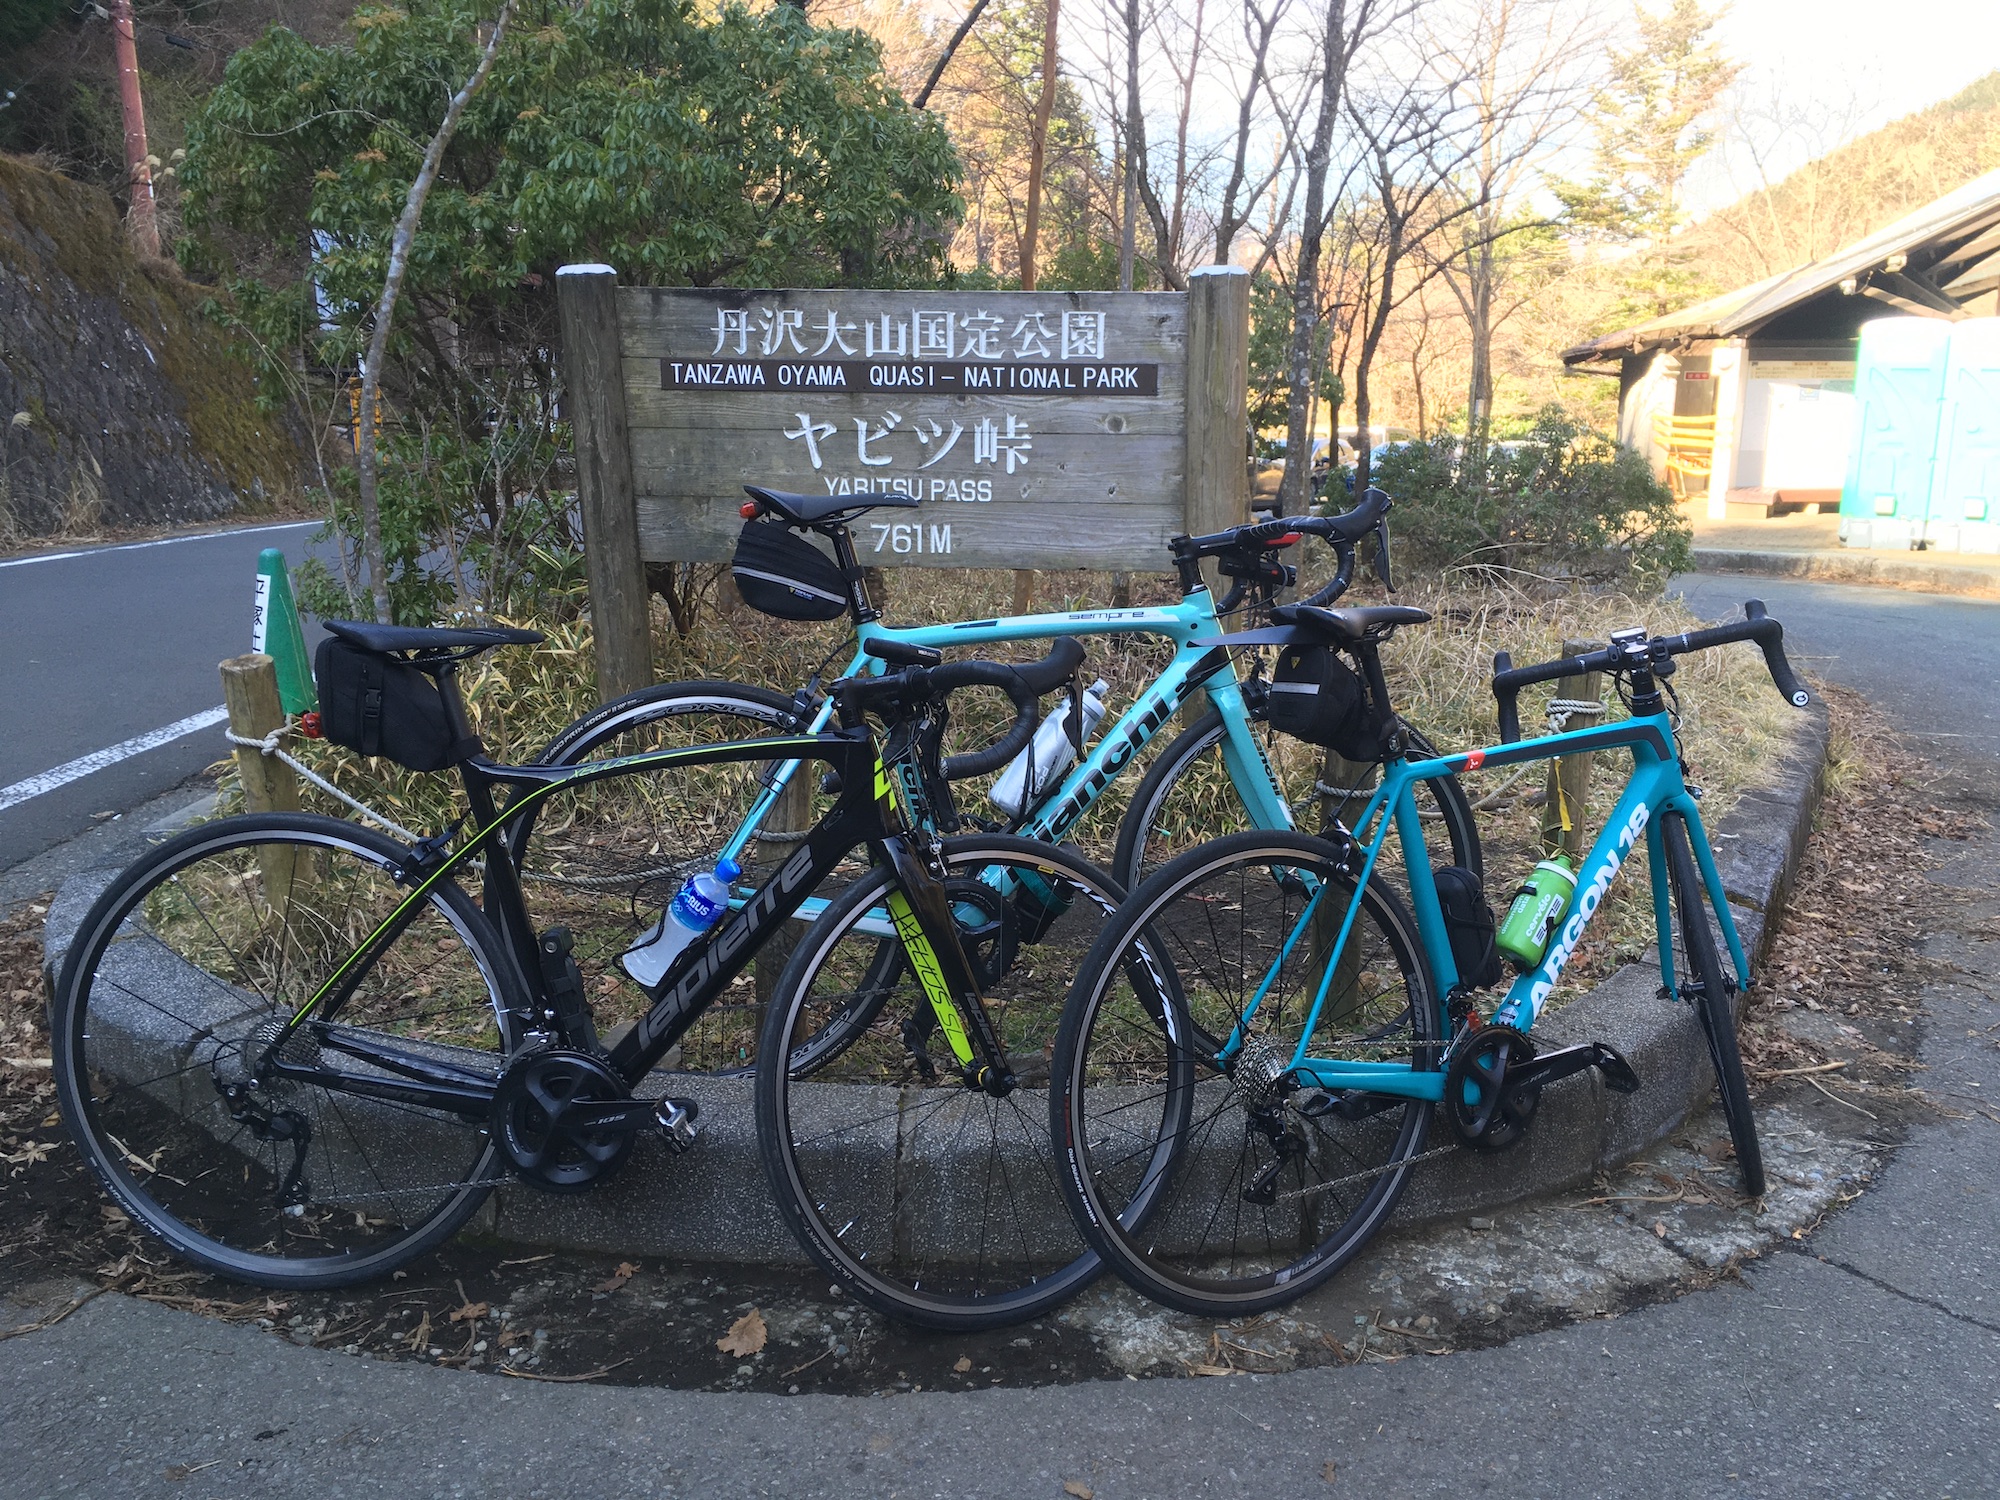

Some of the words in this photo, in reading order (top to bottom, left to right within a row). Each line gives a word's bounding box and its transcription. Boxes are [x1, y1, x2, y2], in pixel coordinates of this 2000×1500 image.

[709, 306, 1107, 360] 丹沢大山国定公園
[670, 363, 766, 386] TANZAWA
[777, 365, 847, 387] OYAMA
[1082, 367, 1139, 389] PARK
[782, 410, 1034, 475] ヤビツ峠
[823, 476, 924, 502] YABITSU
[930, 478, 993, 502] PASS
[869, 522, 953, 555] 761M
[1032, 691, 1171, 845] ianchi
[1529, 848, 1622, 1022] ARGON
[1618, 802, 1651, 849] 18
